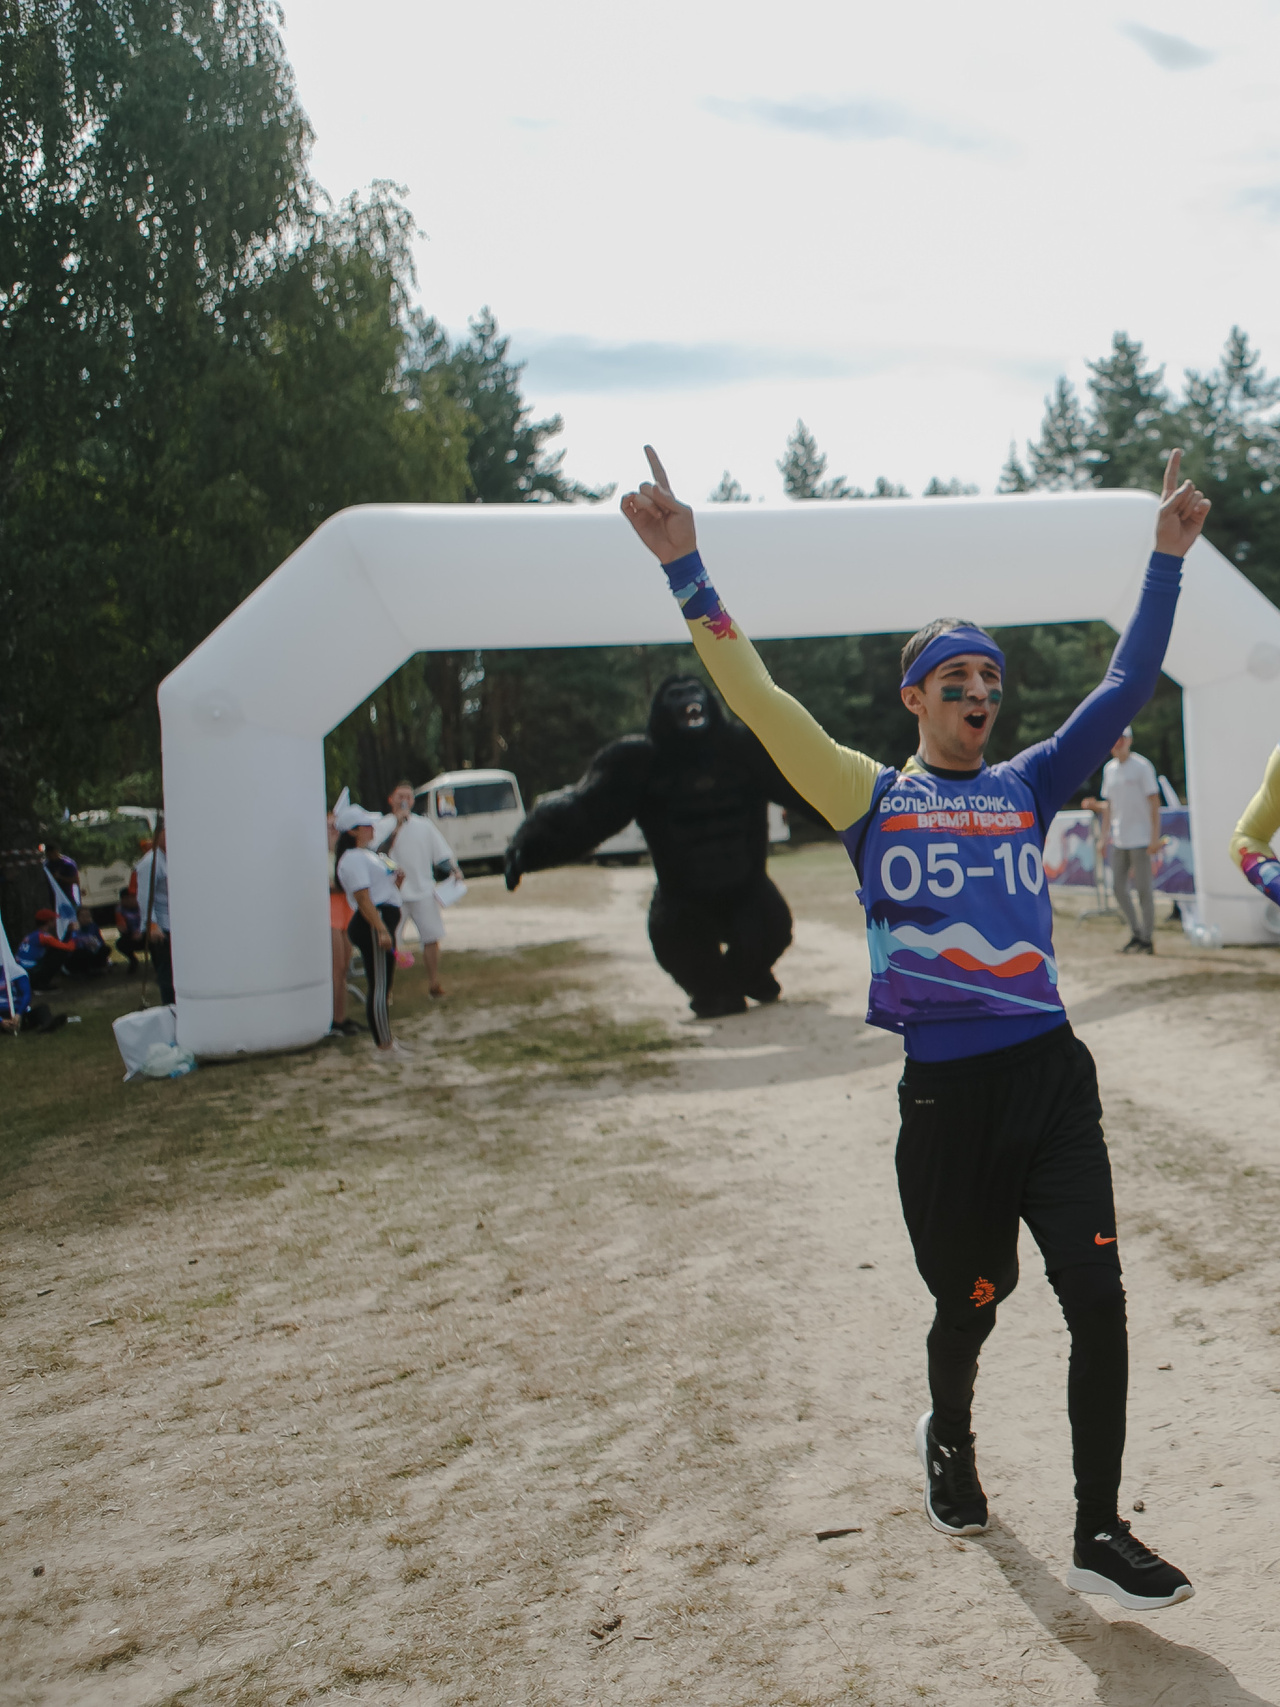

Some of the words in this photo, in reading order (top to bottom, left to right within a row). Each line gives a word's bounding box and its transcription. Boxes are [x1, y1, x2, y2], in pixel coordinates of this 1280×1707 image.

[879, 795, 967, 814] БОЛЬШАЯ
[968, 795, 1017, 812] ГОНКА
[917, 811, 970, 829] ВРЕМЯ
[880, 842, 1045, 901] 05-10
